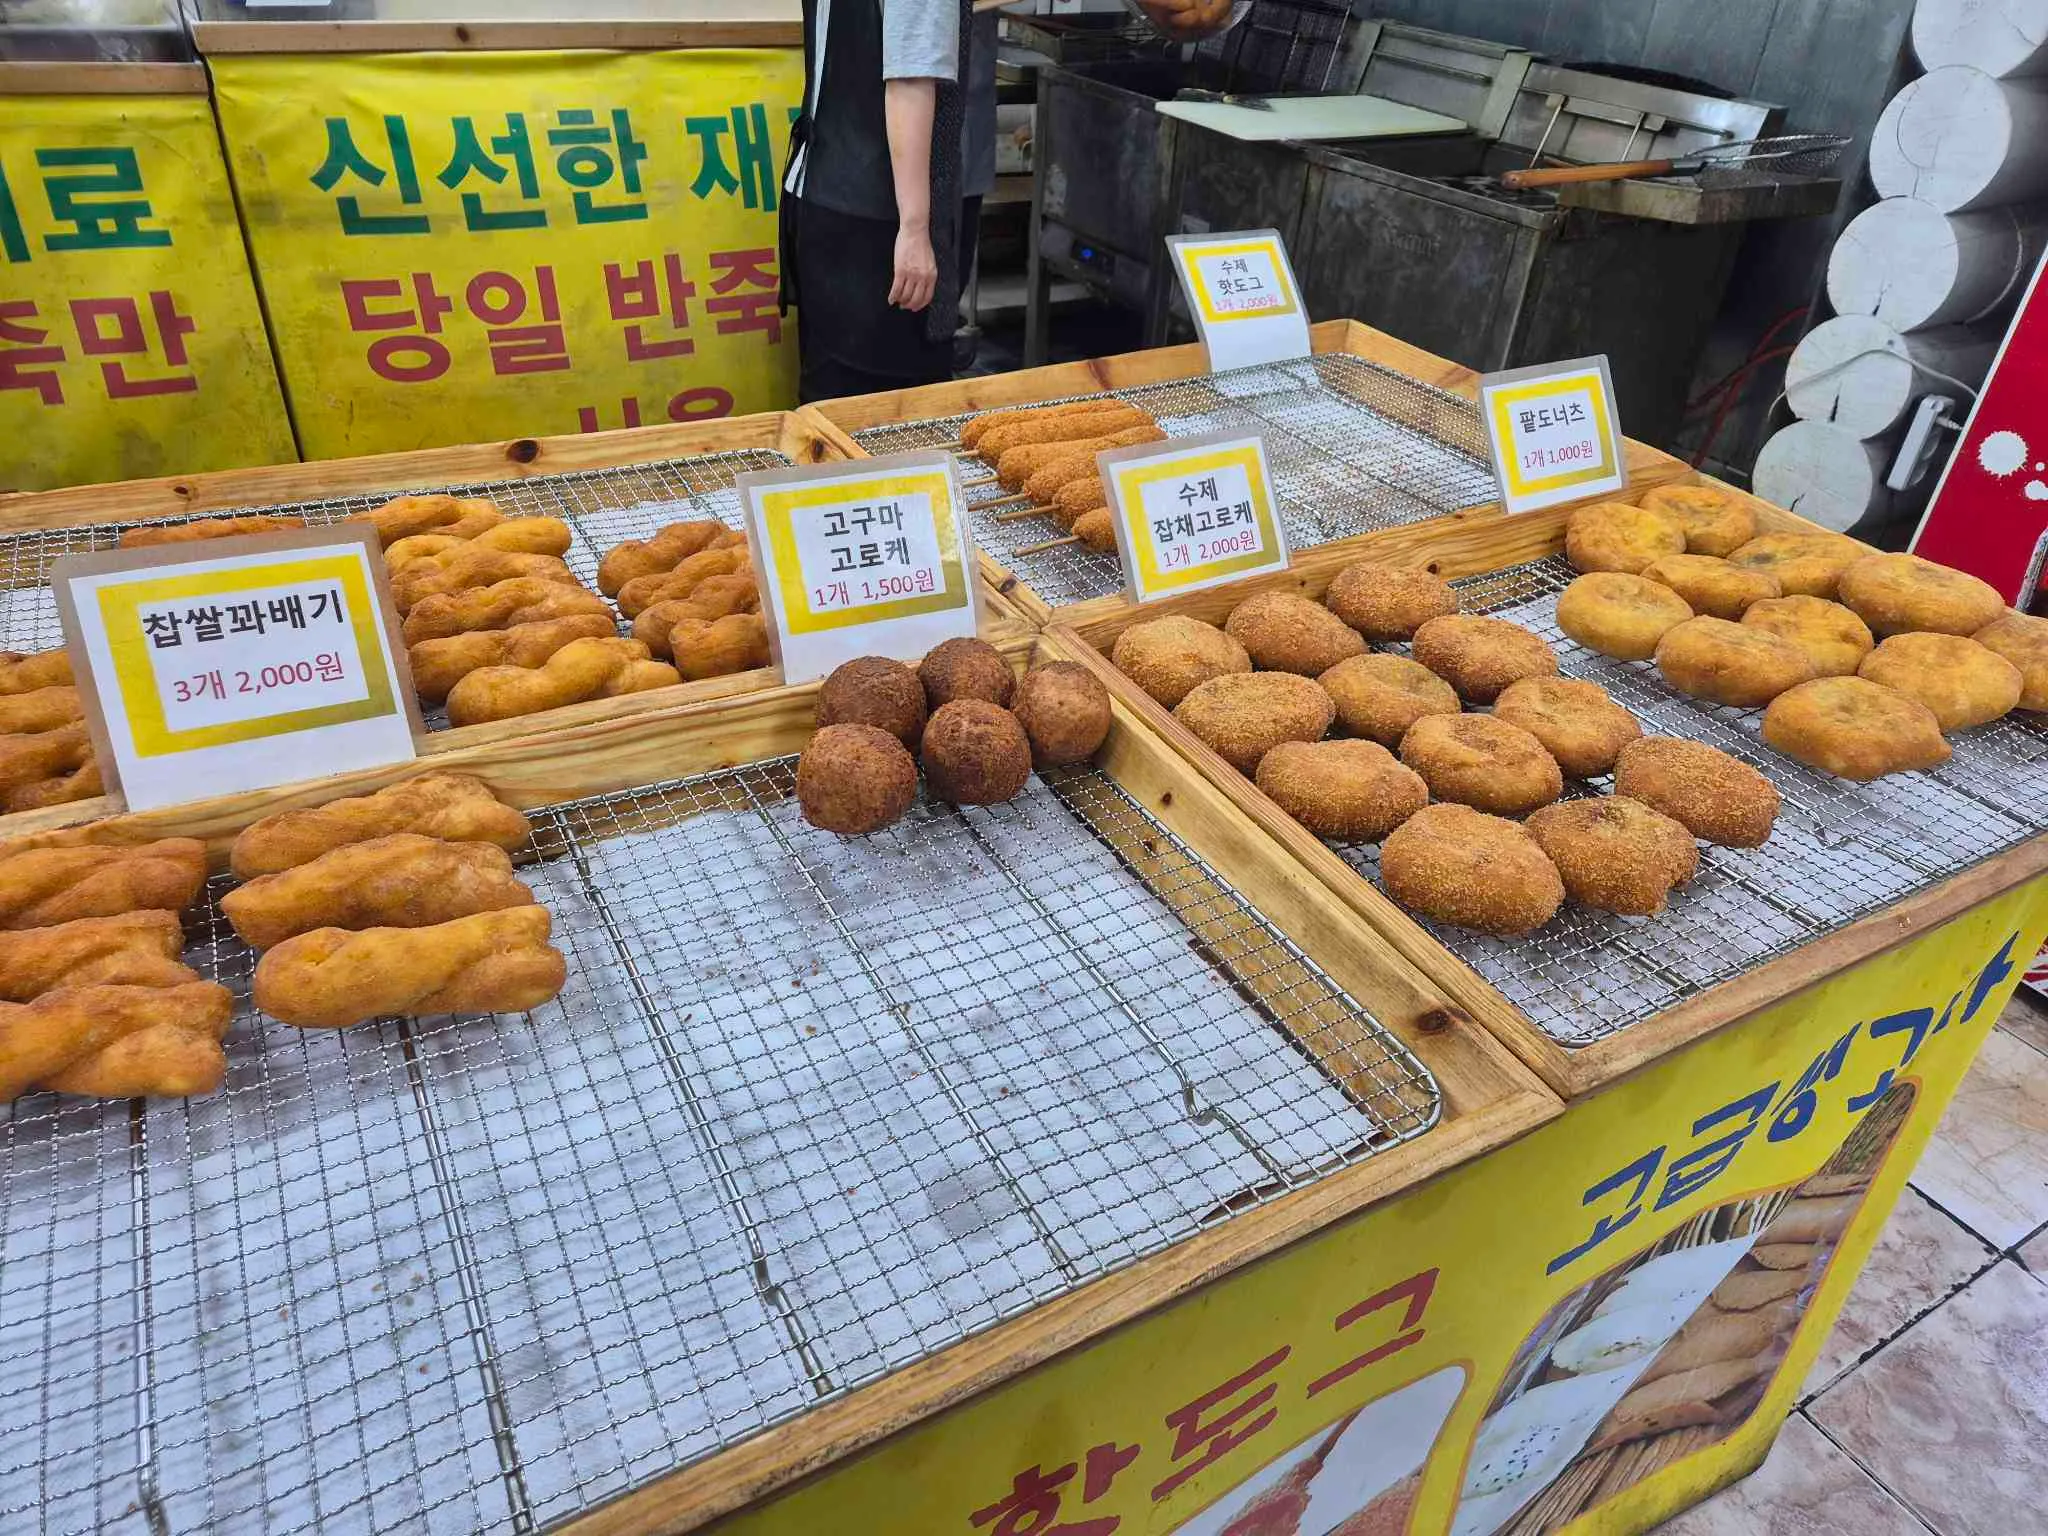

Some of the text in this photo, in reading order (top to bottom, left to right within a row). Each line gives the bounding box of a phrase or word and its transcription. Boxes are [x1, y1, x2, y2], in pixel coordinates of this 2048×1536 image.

[309, 104, 803, 236] 신선한 재
[0, 146, 173, 263] 료
[1217, 276, 1264, 296] 핫도그
[1221, 258, 1248, 275] 수제
[341, 264, 571, 382] 당일
[1519, 402, 1586, 434] 팥도너츠
[1524, 440, 1593, 468] 1개 1,000원
[1178, 477, 1219, 507] 수제
[823, 502, 904, 537] 고구마
[1153, 500, 1254, 543] 잡채고로케
[830, 536, 910, 572] 고로케
[1163, 527, 1257, 568] 1개 2,000원
[815, 567, 936, 607] 1개 1,500원
[142, 589, 344, 649] 찹쌀꽈배기
[173, 651, 345, 702] 3개 2,000원
